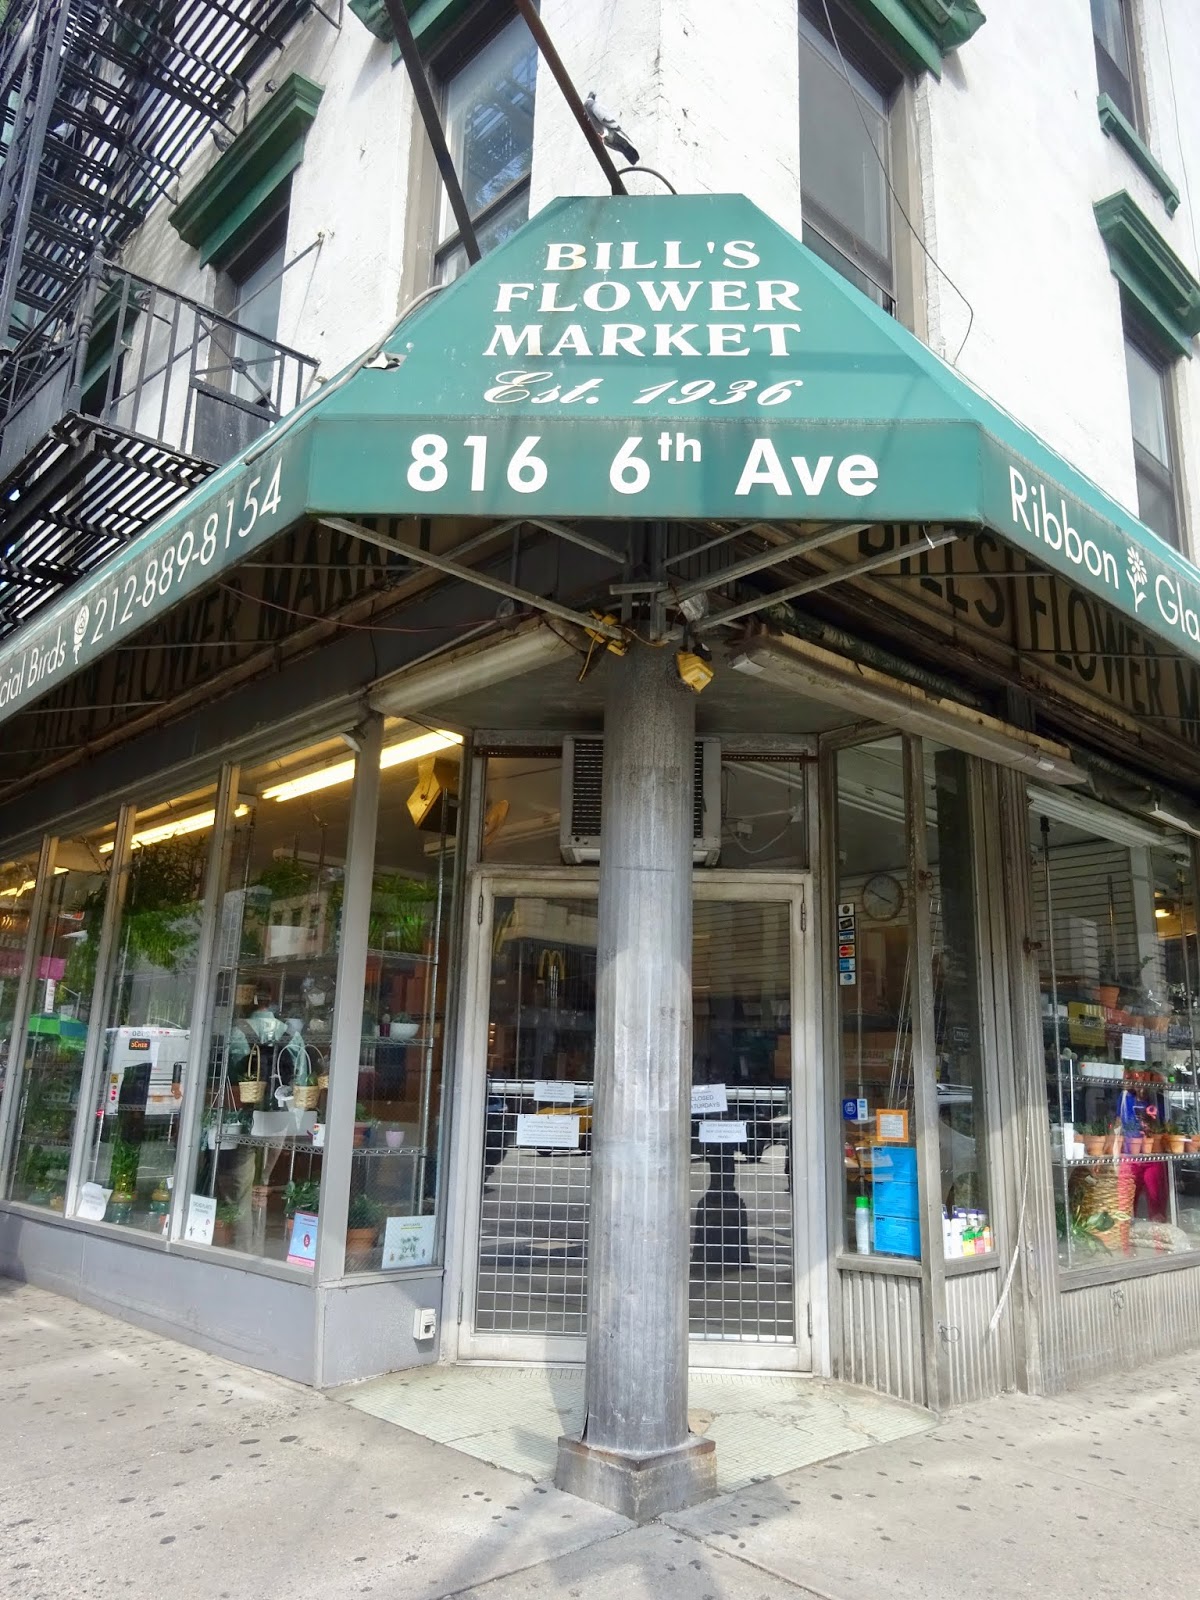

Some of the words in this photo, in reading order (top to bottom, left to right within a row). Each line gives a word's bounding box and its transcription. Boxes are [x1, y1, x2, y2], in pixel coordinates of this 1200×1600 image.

[544, 240, 760, 272] BILL'S
[493, 280, 802, 314] FLOWER
[482, 322, 802, 357] MARKET
[483, 370, 600, 406] Est.
[632, 378, 804, 407] 1936
[406, 433, 548, 493] 816
[609, 431, 702, 495] 6th
[734, 438, 880, 497] Ave
[1008, 465, 1120, 590] Ribbon
[0, 652, 26, 707] cial
[28, 625, 67, 688] Birds
[91, 457, 283, 645] 212-889-8154
[691, 1101, 720, 1109] TURDAYS
